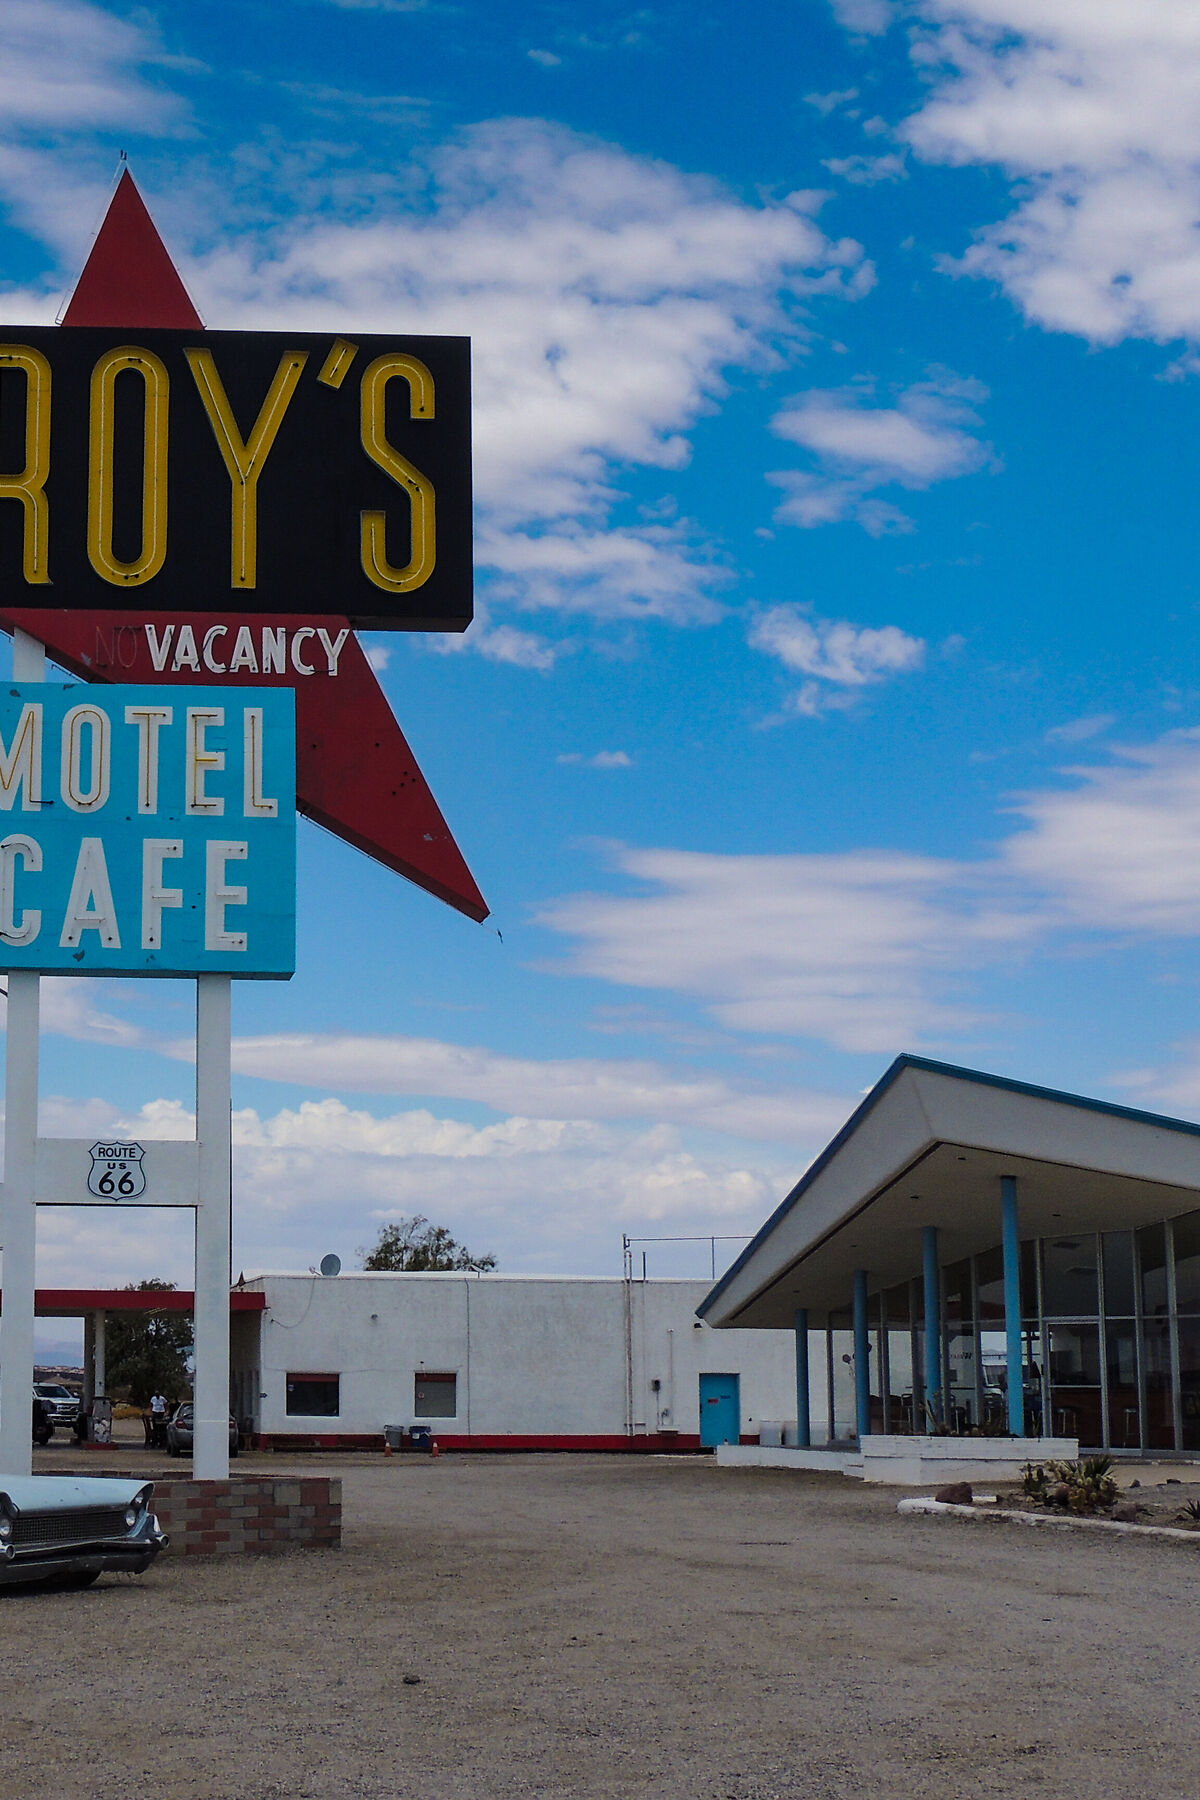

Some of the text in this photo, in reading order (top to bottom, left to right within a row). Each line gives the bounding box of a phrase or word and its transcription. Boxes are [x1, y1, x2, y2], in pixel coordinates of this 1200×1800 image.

[144, 624, 350, 677] VACANCY
[98, 1147, 136, 1158] ROUTE
[107, 1162, 127, 1170] US
[98, 1171, 135, 1195] 66
